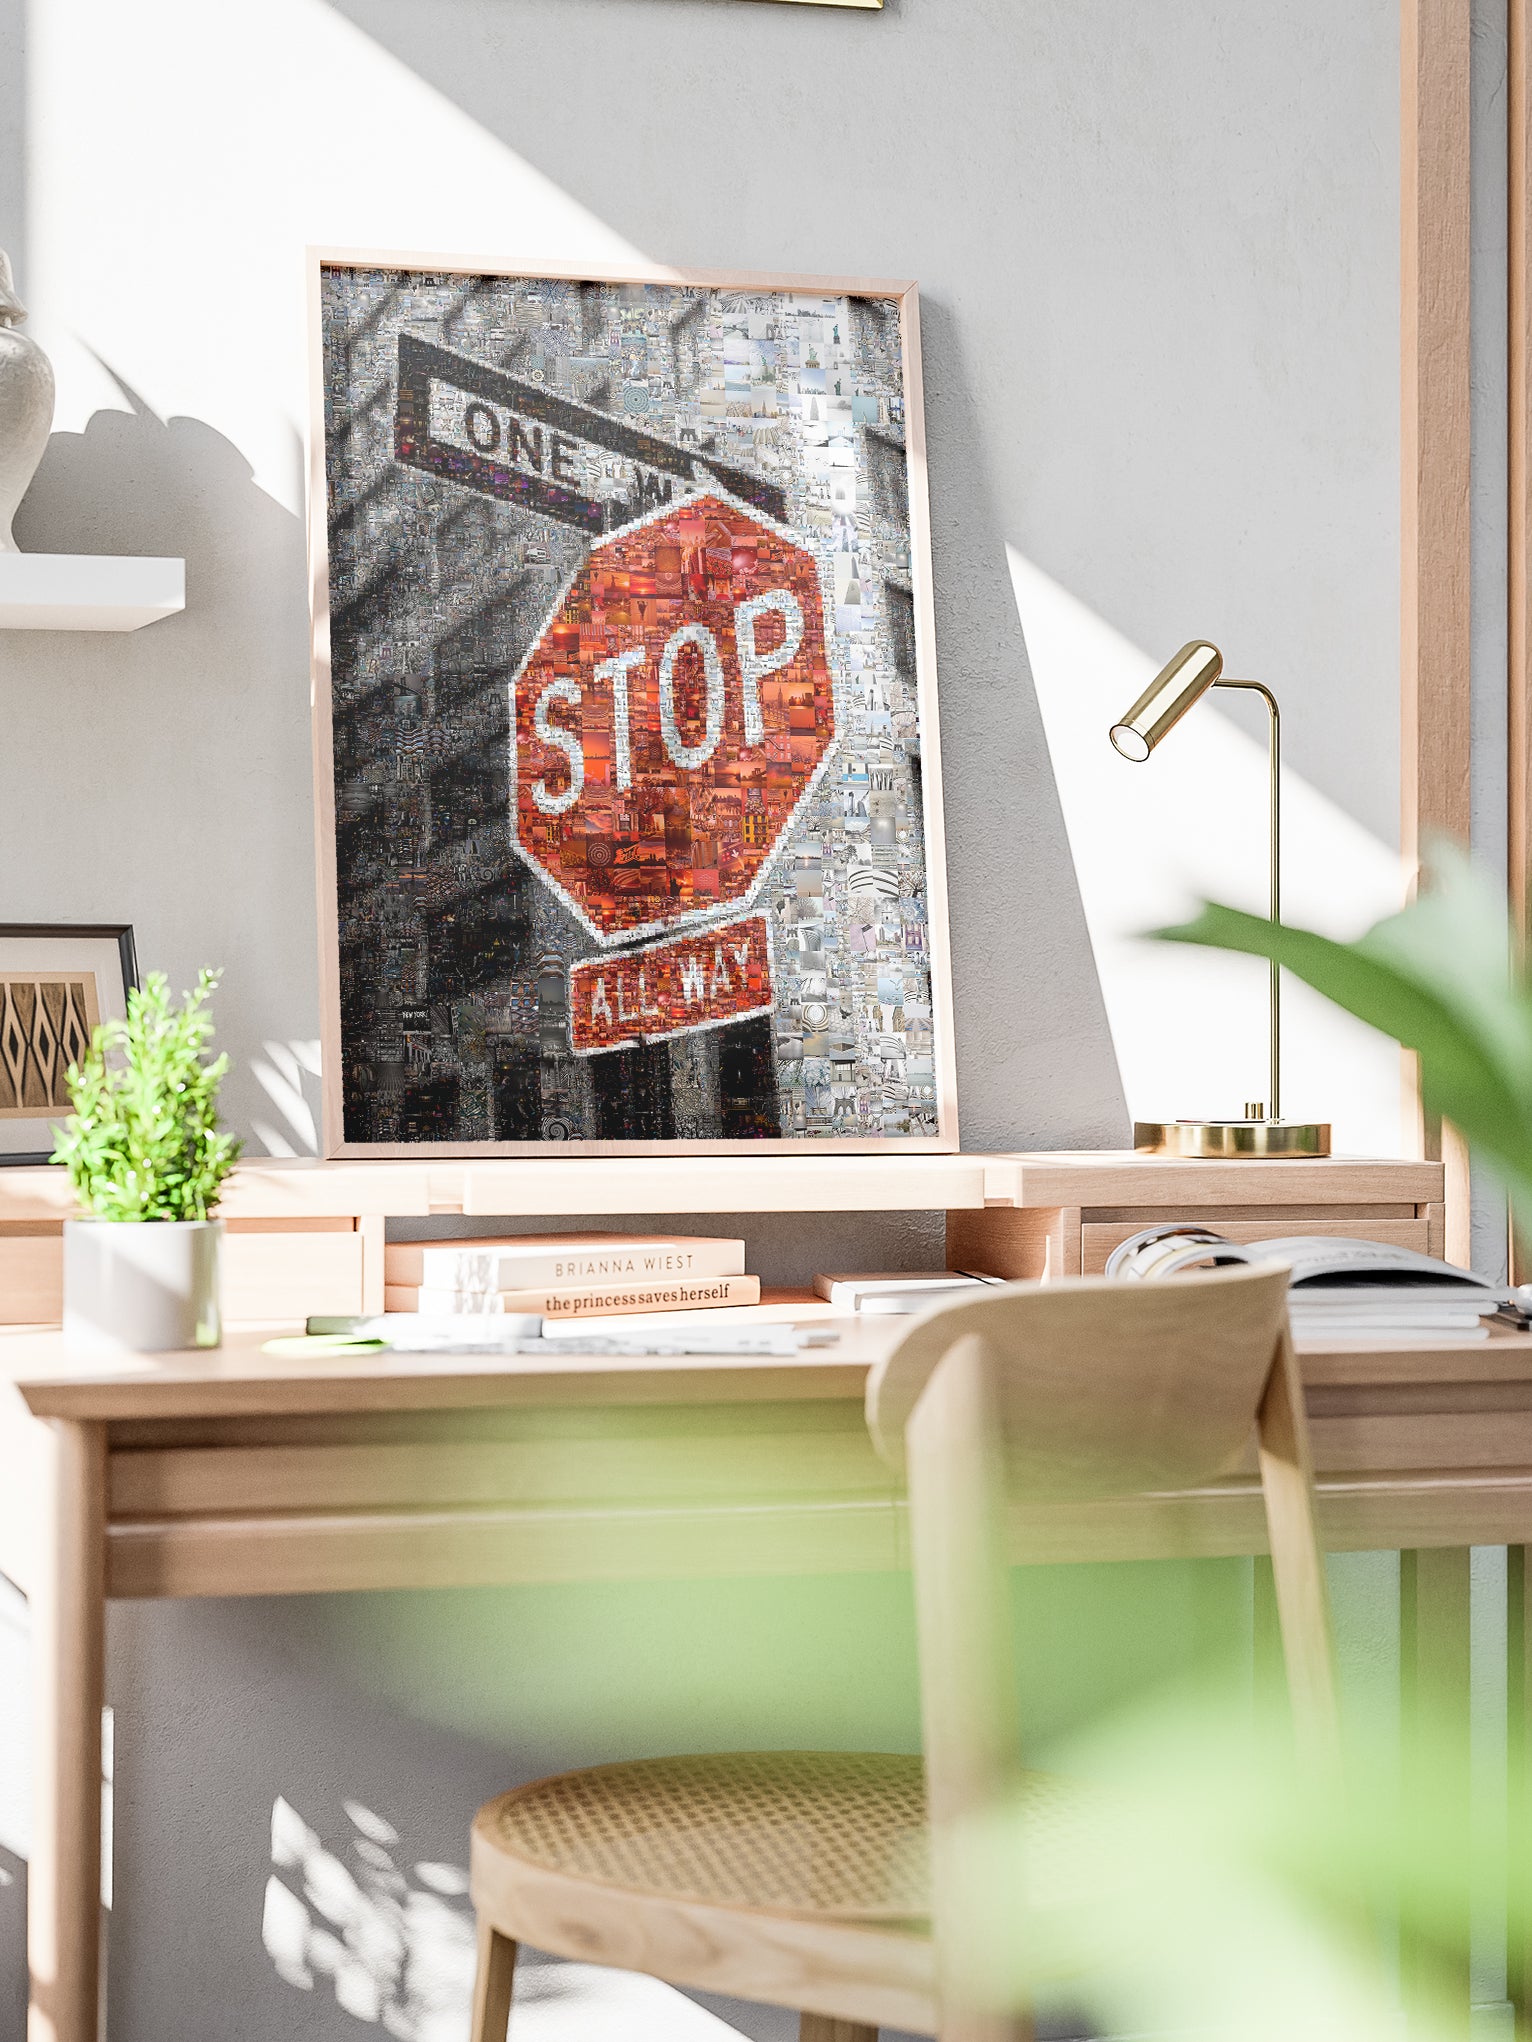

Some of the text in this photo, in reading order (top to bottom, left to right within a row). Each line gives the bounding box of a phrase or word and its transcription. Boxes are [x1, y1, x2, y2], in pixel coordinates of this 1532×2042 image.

[465, 402, 581, 490] ONE
[533, 589, 804, 815] STOP
[591, 937, 751, 1027] ALL WAY
[546, 1283, 731, 1313] the princess saves herself
[555, 1254, 694, 1278] BRIANNA WIEST
